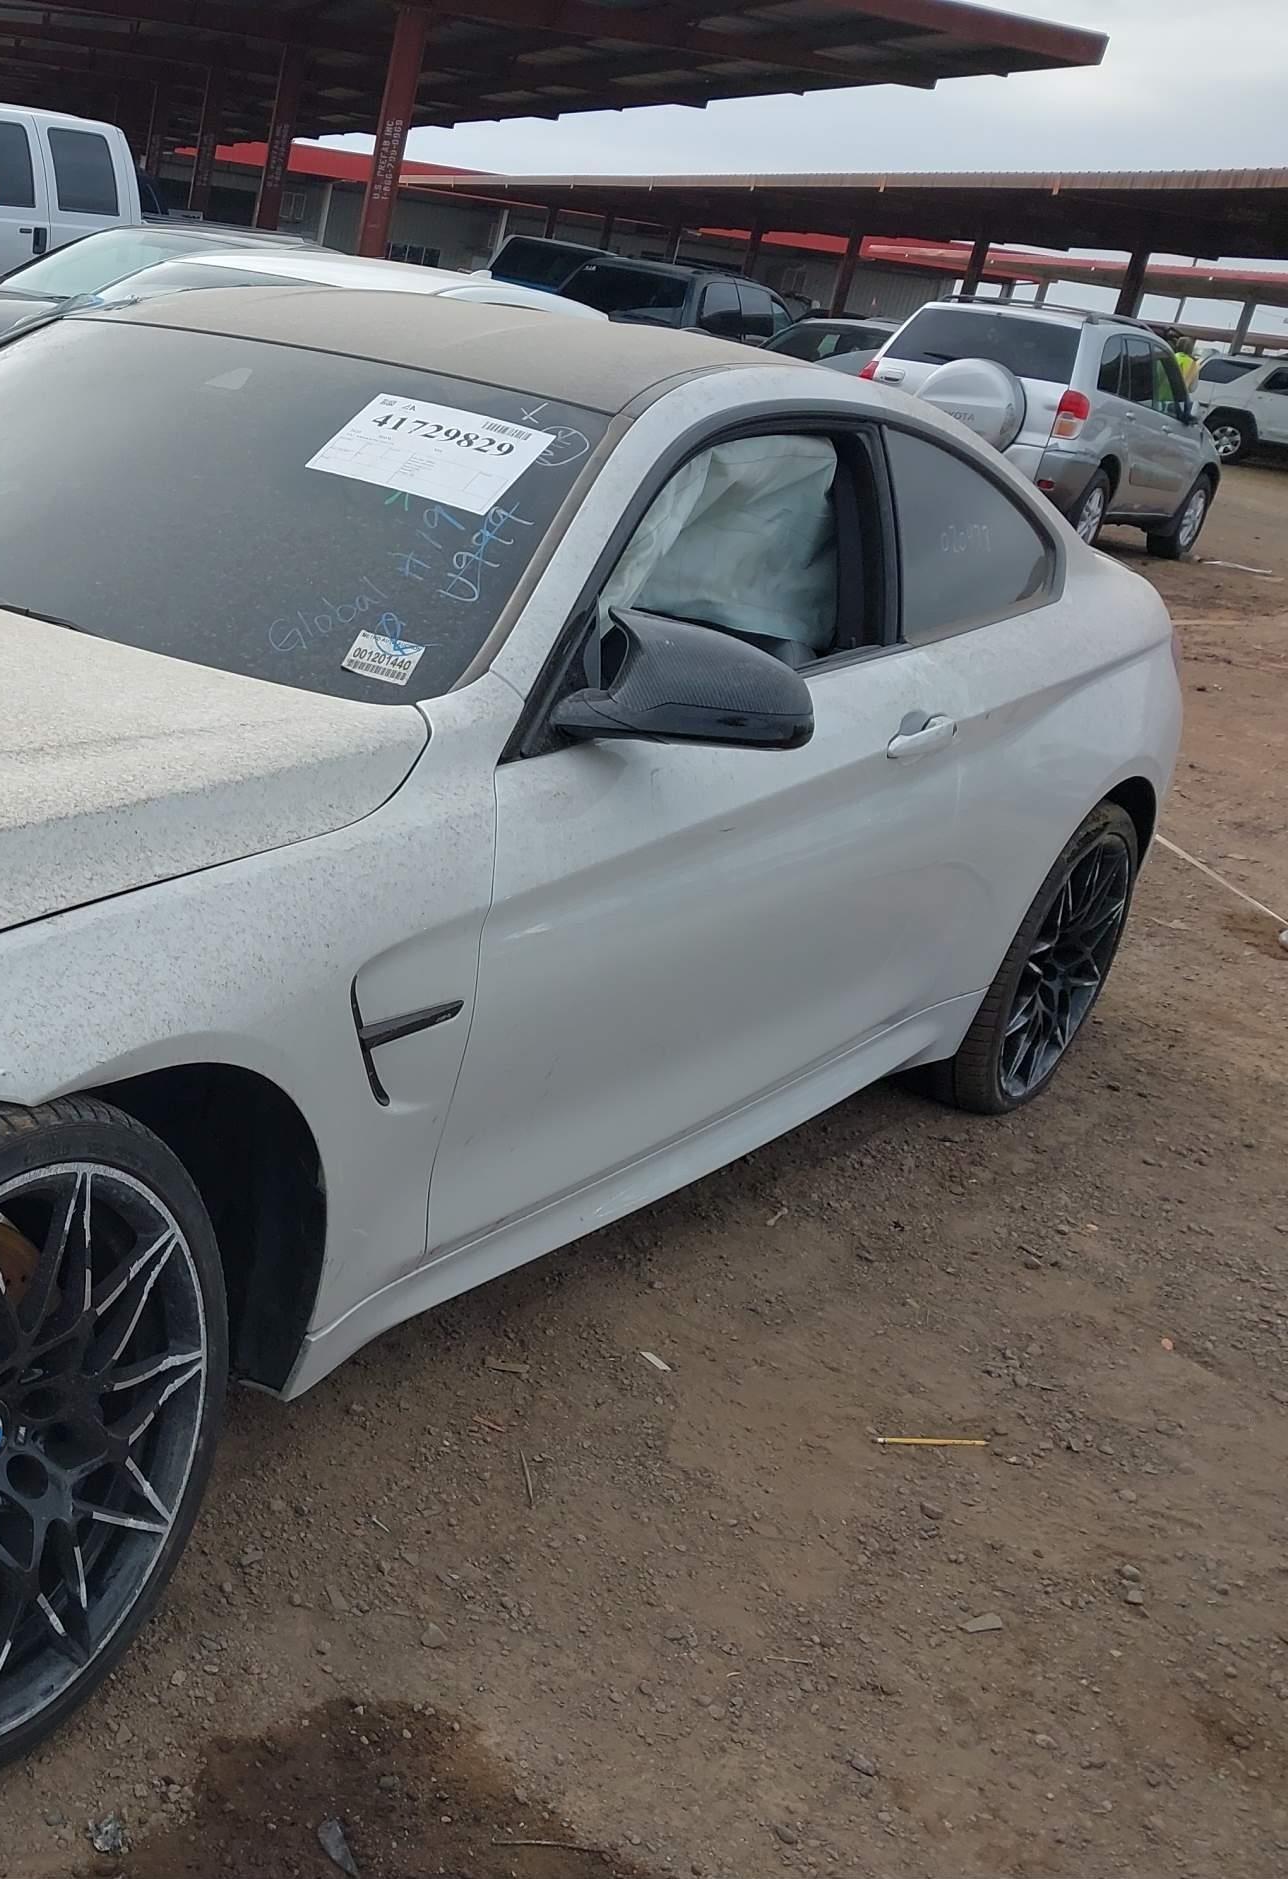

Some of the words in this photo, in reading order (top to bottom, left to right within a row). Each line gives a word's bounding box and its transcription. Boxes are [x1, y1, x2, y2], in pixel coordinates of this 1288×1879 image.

[372, 413, 515, 457] 41729829
[268, 575, 388, 651] Global
[352, 647, 412, 671] 001201440
